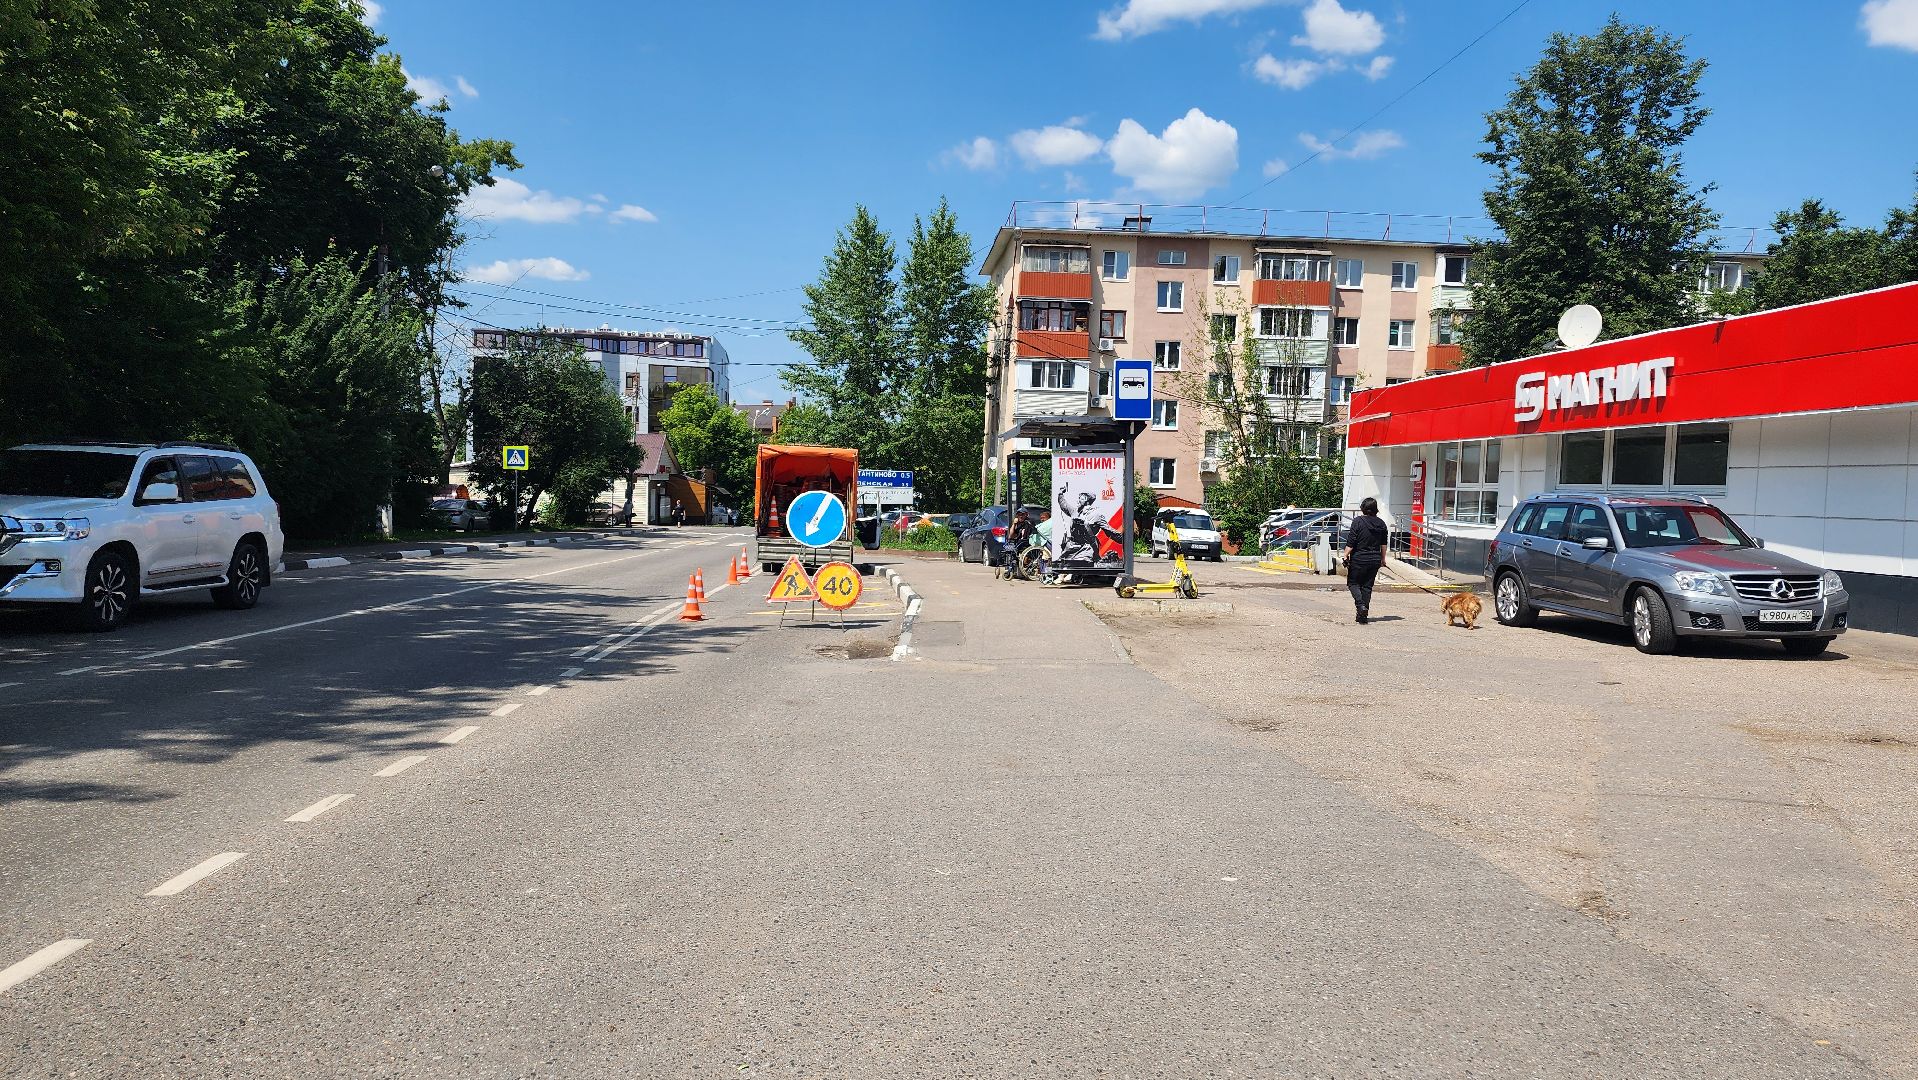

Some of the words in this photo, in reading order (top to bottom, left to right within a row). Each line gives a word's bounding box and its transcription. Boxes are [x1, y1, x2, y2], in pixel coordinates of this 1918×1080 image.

[1547, 357, 1675, 411] МАГНИТ
[1058, 457, 1116, 470] ПОМНИМ!
[822, 576, 853, 596] 40
